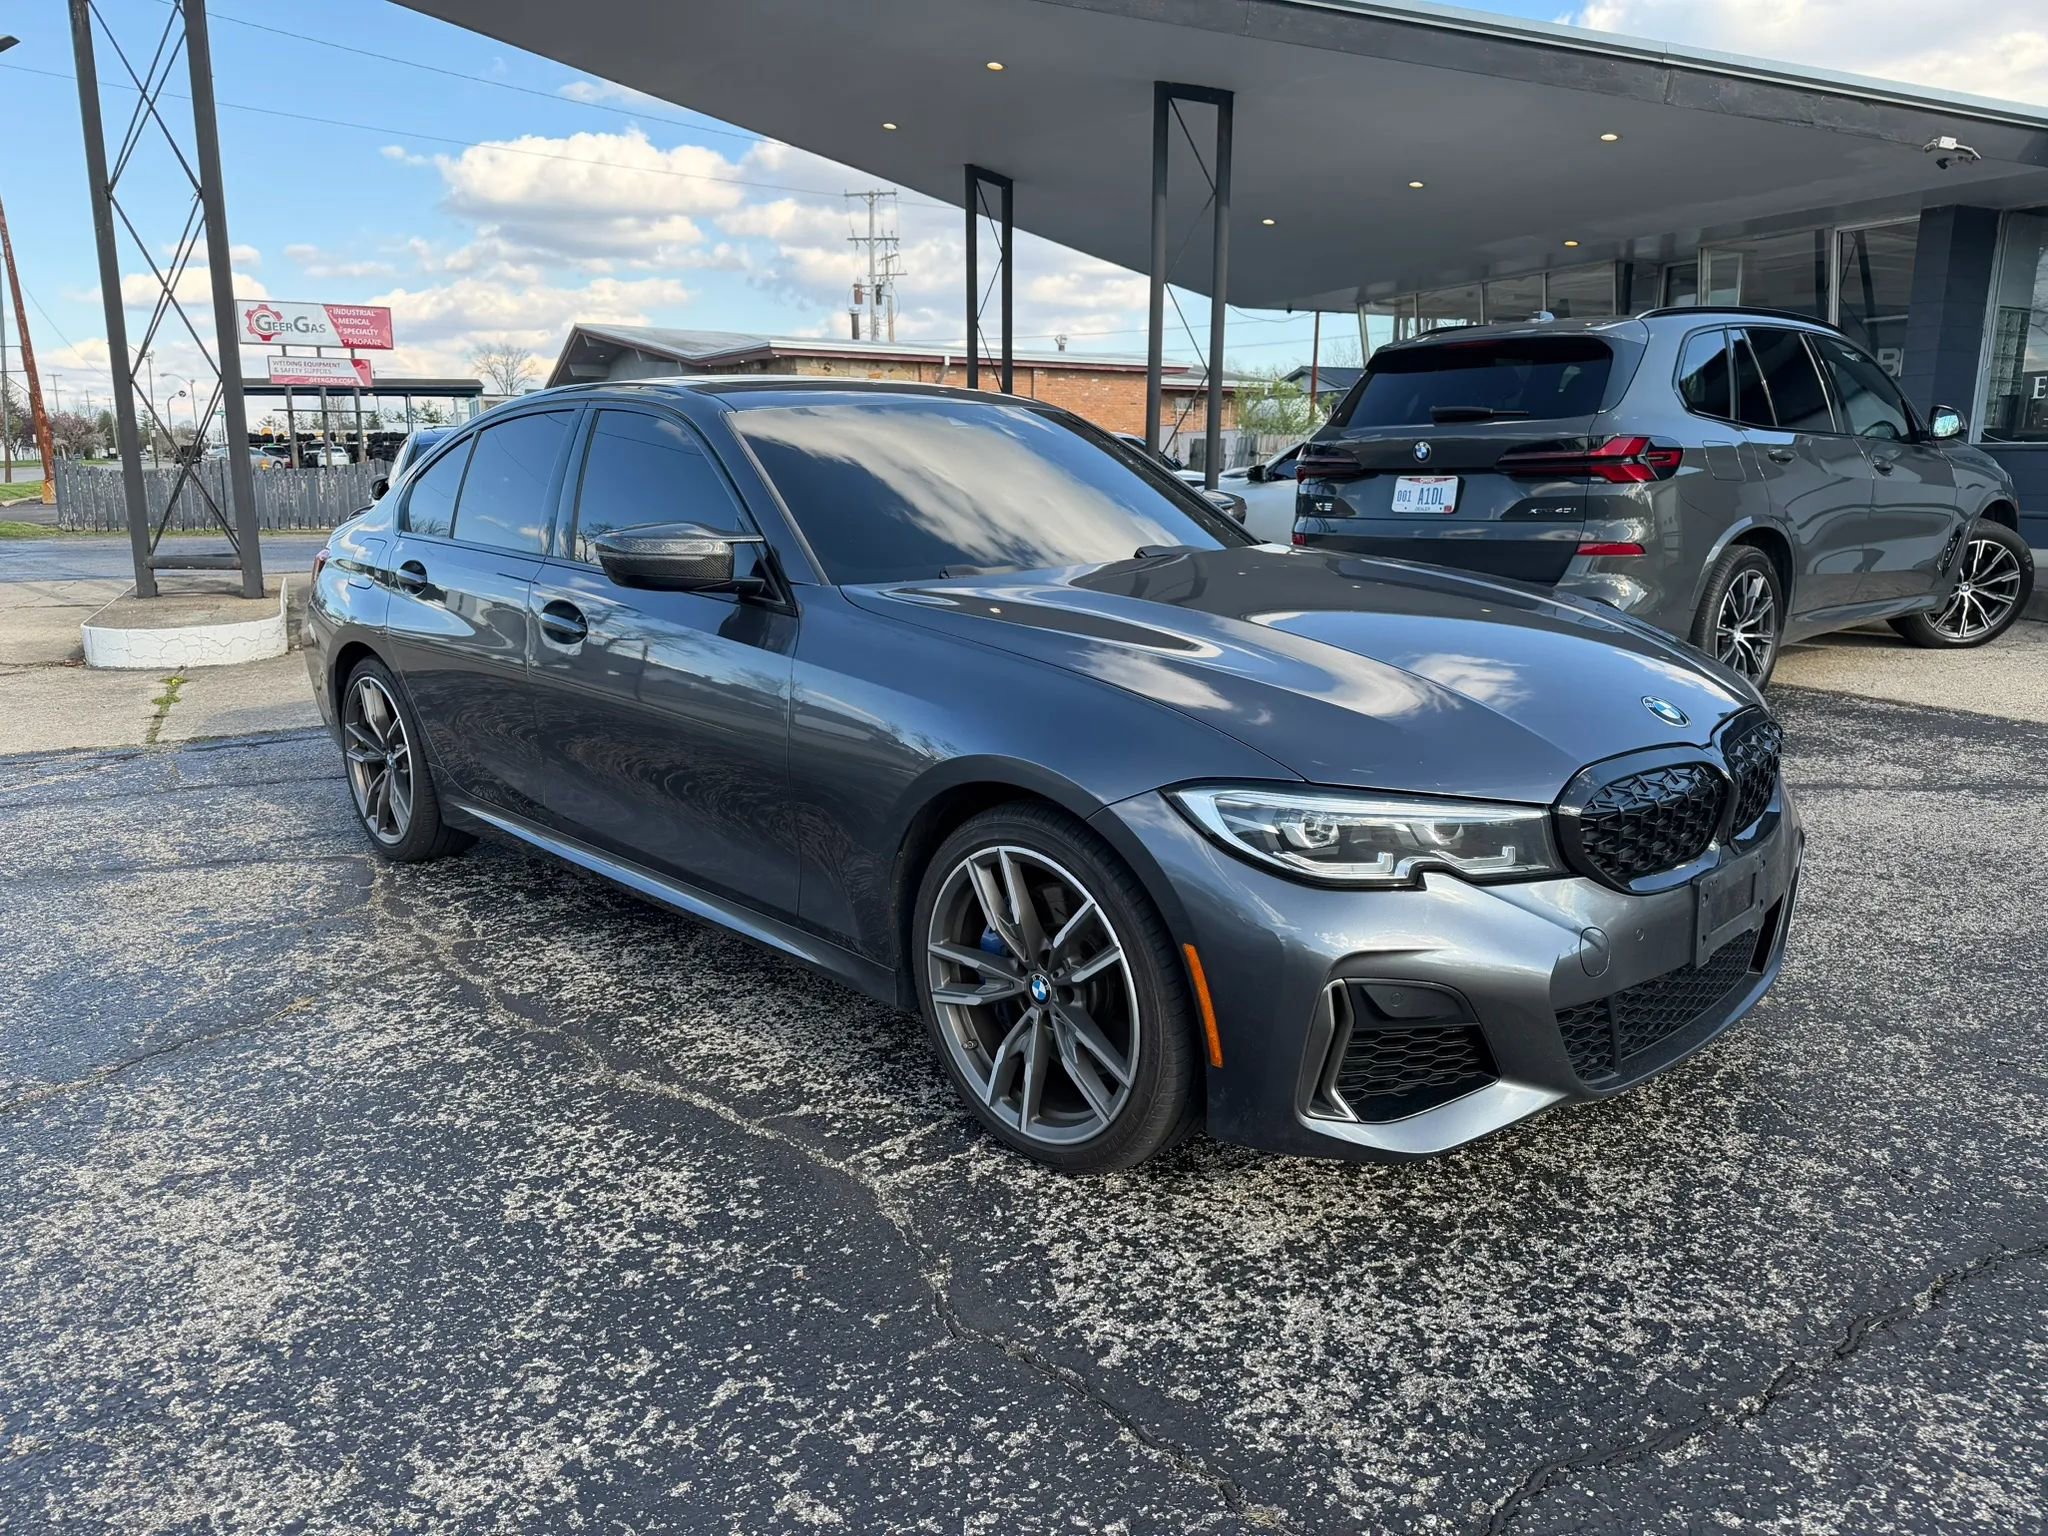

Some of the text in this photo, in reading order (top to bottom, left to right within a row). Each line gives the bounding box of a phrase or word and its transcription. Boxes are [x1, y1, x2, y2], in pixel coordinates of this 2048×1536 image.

[333, 308, 376, 317] INDUSTRIAL
[338, 317, 371, 326] MEDICAL
[343, 327, 379, 336] SPECIALTY
[348, 337, 382, 346] PROPANE
[1396, 487, 1445, 505] 001 A1DL
